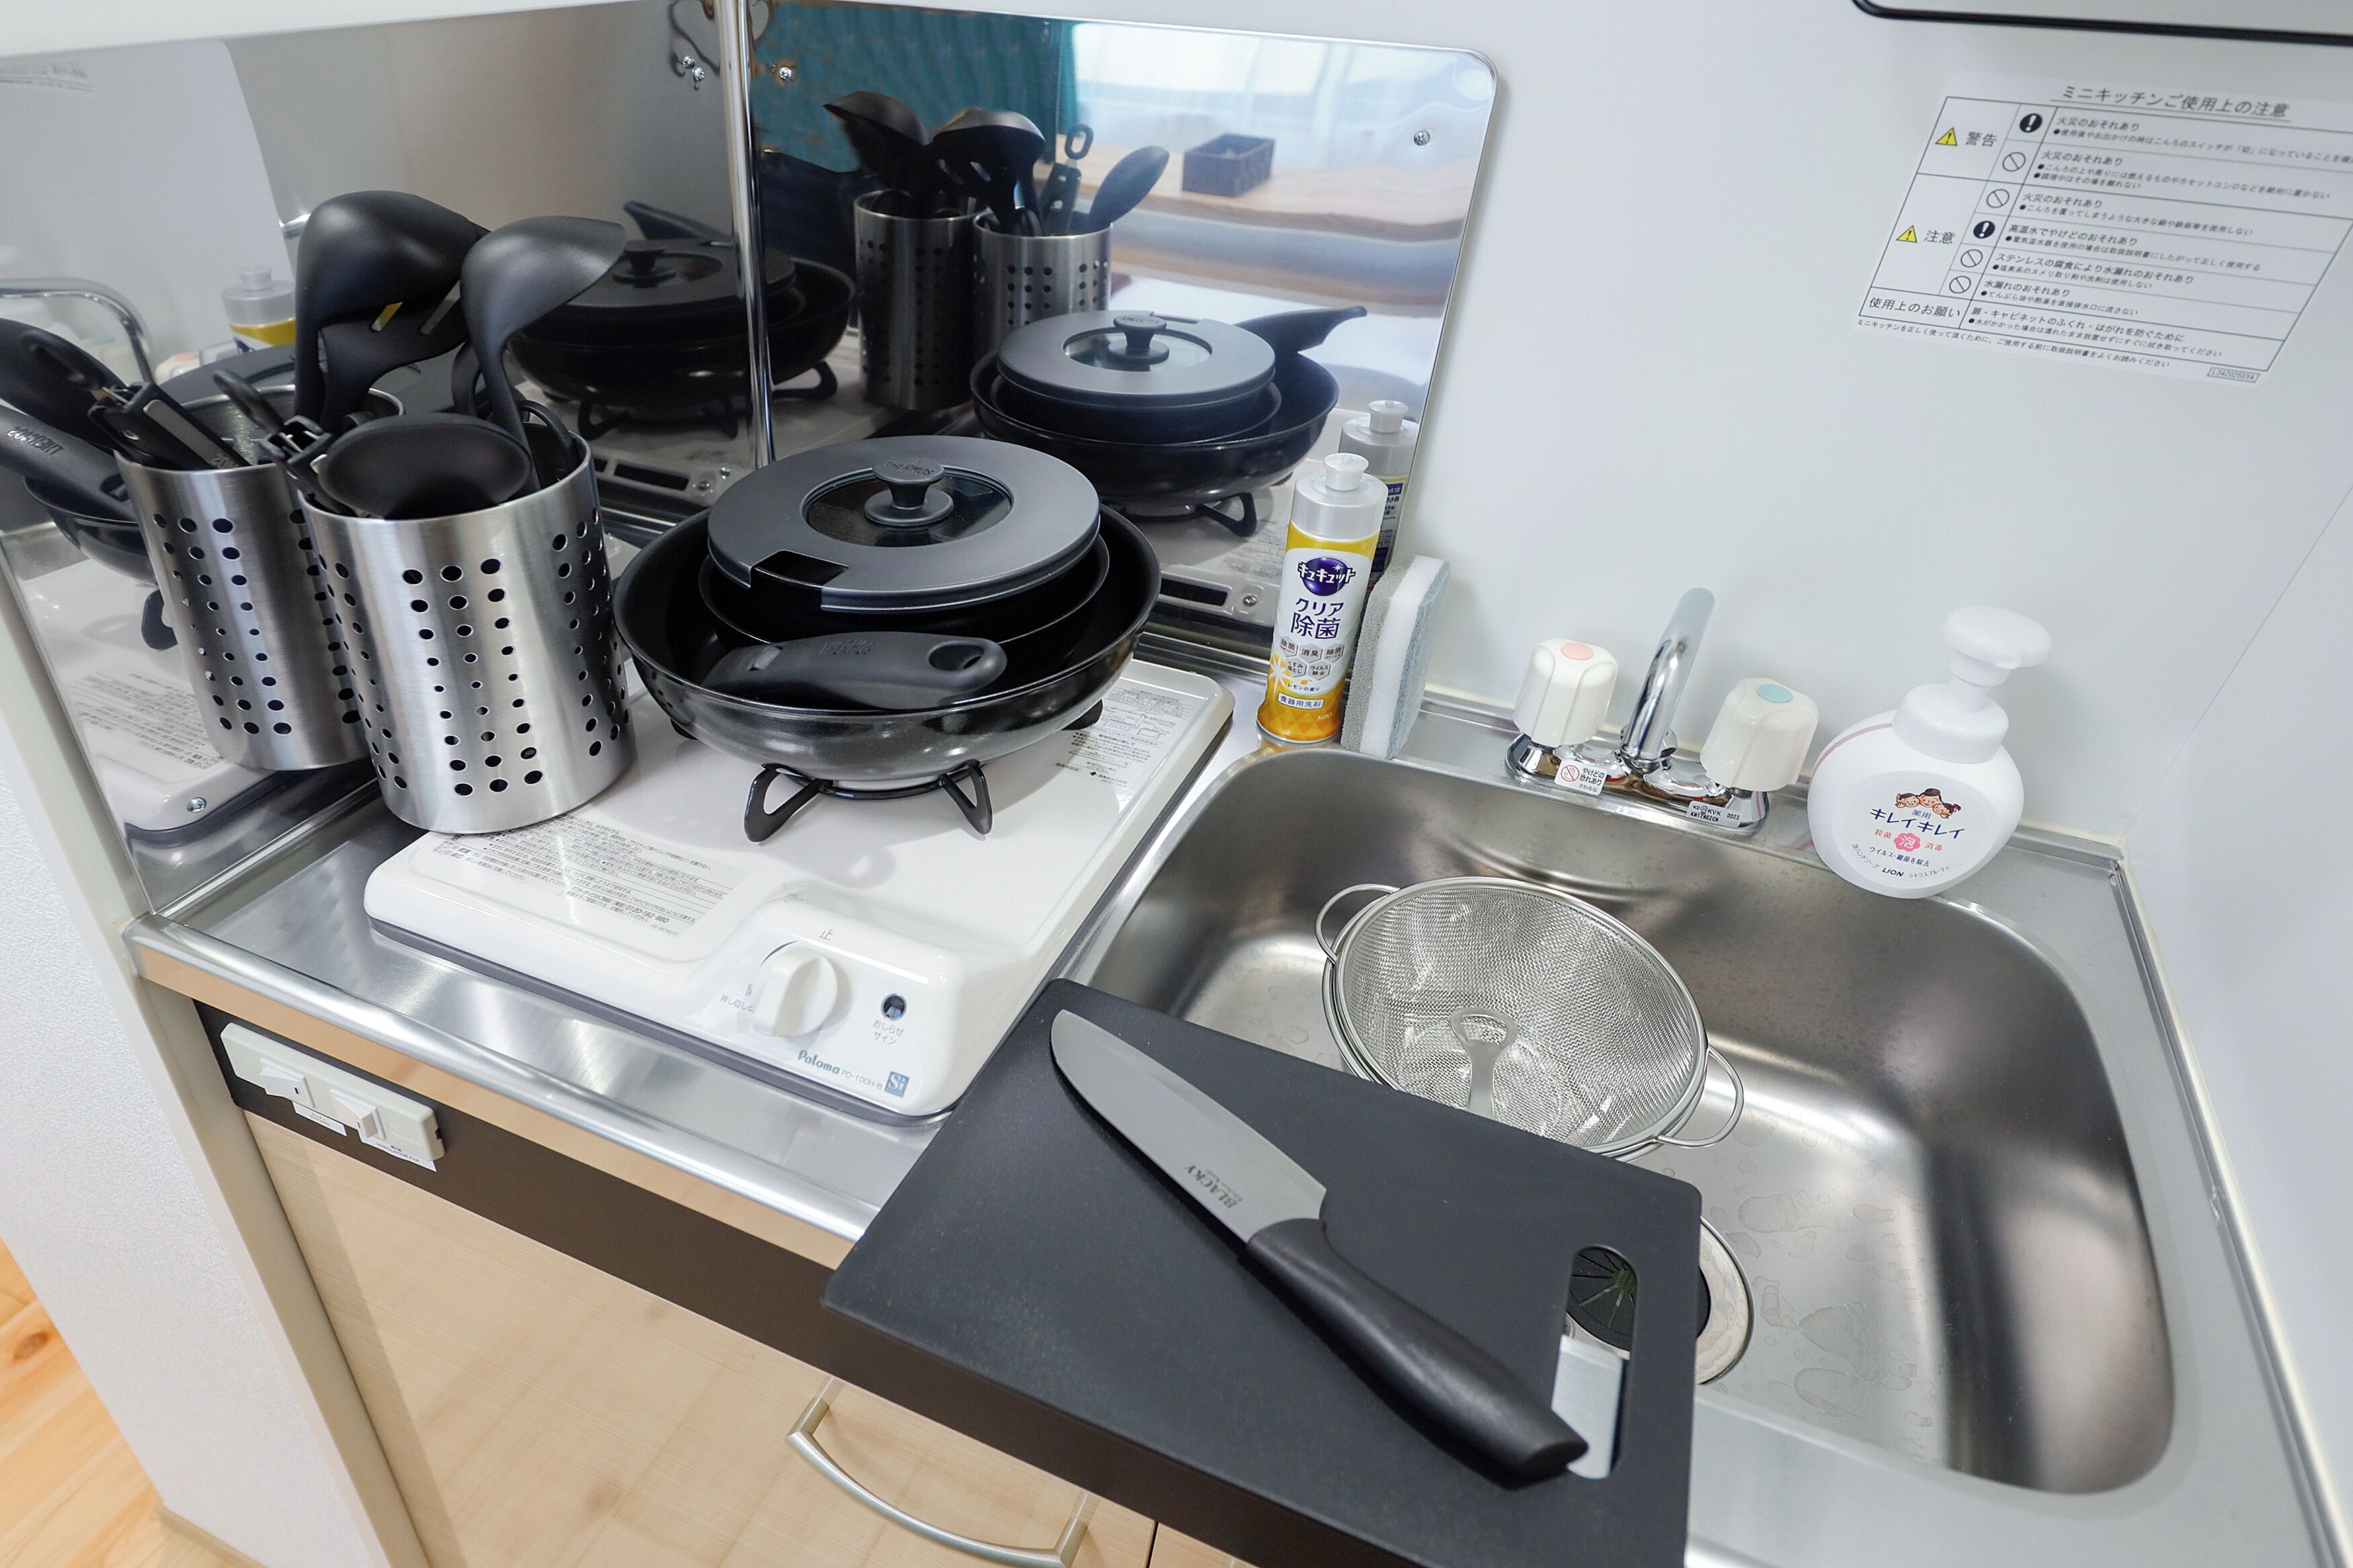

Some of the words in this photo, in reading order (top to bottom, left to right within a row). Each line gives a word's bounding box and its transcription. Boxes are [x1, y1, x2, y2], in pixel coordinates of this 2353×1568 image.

[2063, 85, 2290, 118] ミニキッチンご使用上の注意
[2057, 116, 2140, 131] 火災のおそれあり
[1965, 131, 1997, 147] 警告
[2040, 150, 2123, 166] 火災のおそれあり
[2022, 192, 2103, 209] 火災のおそれあり
[1923, 230, 1956, 245] 注意
[2008, 223, 2138, 246] 高温水でやけどのおそれあり
[1995, 253, 2194, 284] ステンレスの腐食により水漏れのおそれあり
[1984, 279, 2071, 298] 水漏れのおそれあり
[1868, 296, 1961, 318] 使用上のお願い
[1970, 307, 2185, 343] 扉・キャビネットのふくれ・はがれを防ぐために
[1297, 560, 1357, 584] キュキュット
[1295, 597, 1345, 617] クリア
[1291, 612, 1341, 639] 除菌
[1281, 638, 1295, 651] 除菌
[1301, 648, 1319, 657] 消臭
[1287, 683, 1320, 692] レモンの香り
[1279, 695, 1322, 708] 食器用洗剤
[1579, 774, 1603, 786] 恐れあり
[1583, 767, 1605, 779] やけどの
[1579, 784, 1598, 792] さわるな
[1708, 809, 1722, 817] KVK
[1911, 809, 1932, 820] 薬用
[1870, 808, 1966, 839] キレイキレイ
[1874, 829, 1892, 839] 殺菌
[1900, 834, 1916, 849] 泡
[1925, 841, 1944, 852] 消毒
[1869, 846, 1931, 868] ウイルス・細菌を除去
[1882, 866, 1905, 878] LION
[818, 928, 834, 941] 止
[872, 1020, 905, 1037] おしらせ
[873, 1030, 898, 1046] サイン
[797, 1049, 841, 1075] Paloma
[1184, 1165, 1238, 1209] BLACKY
